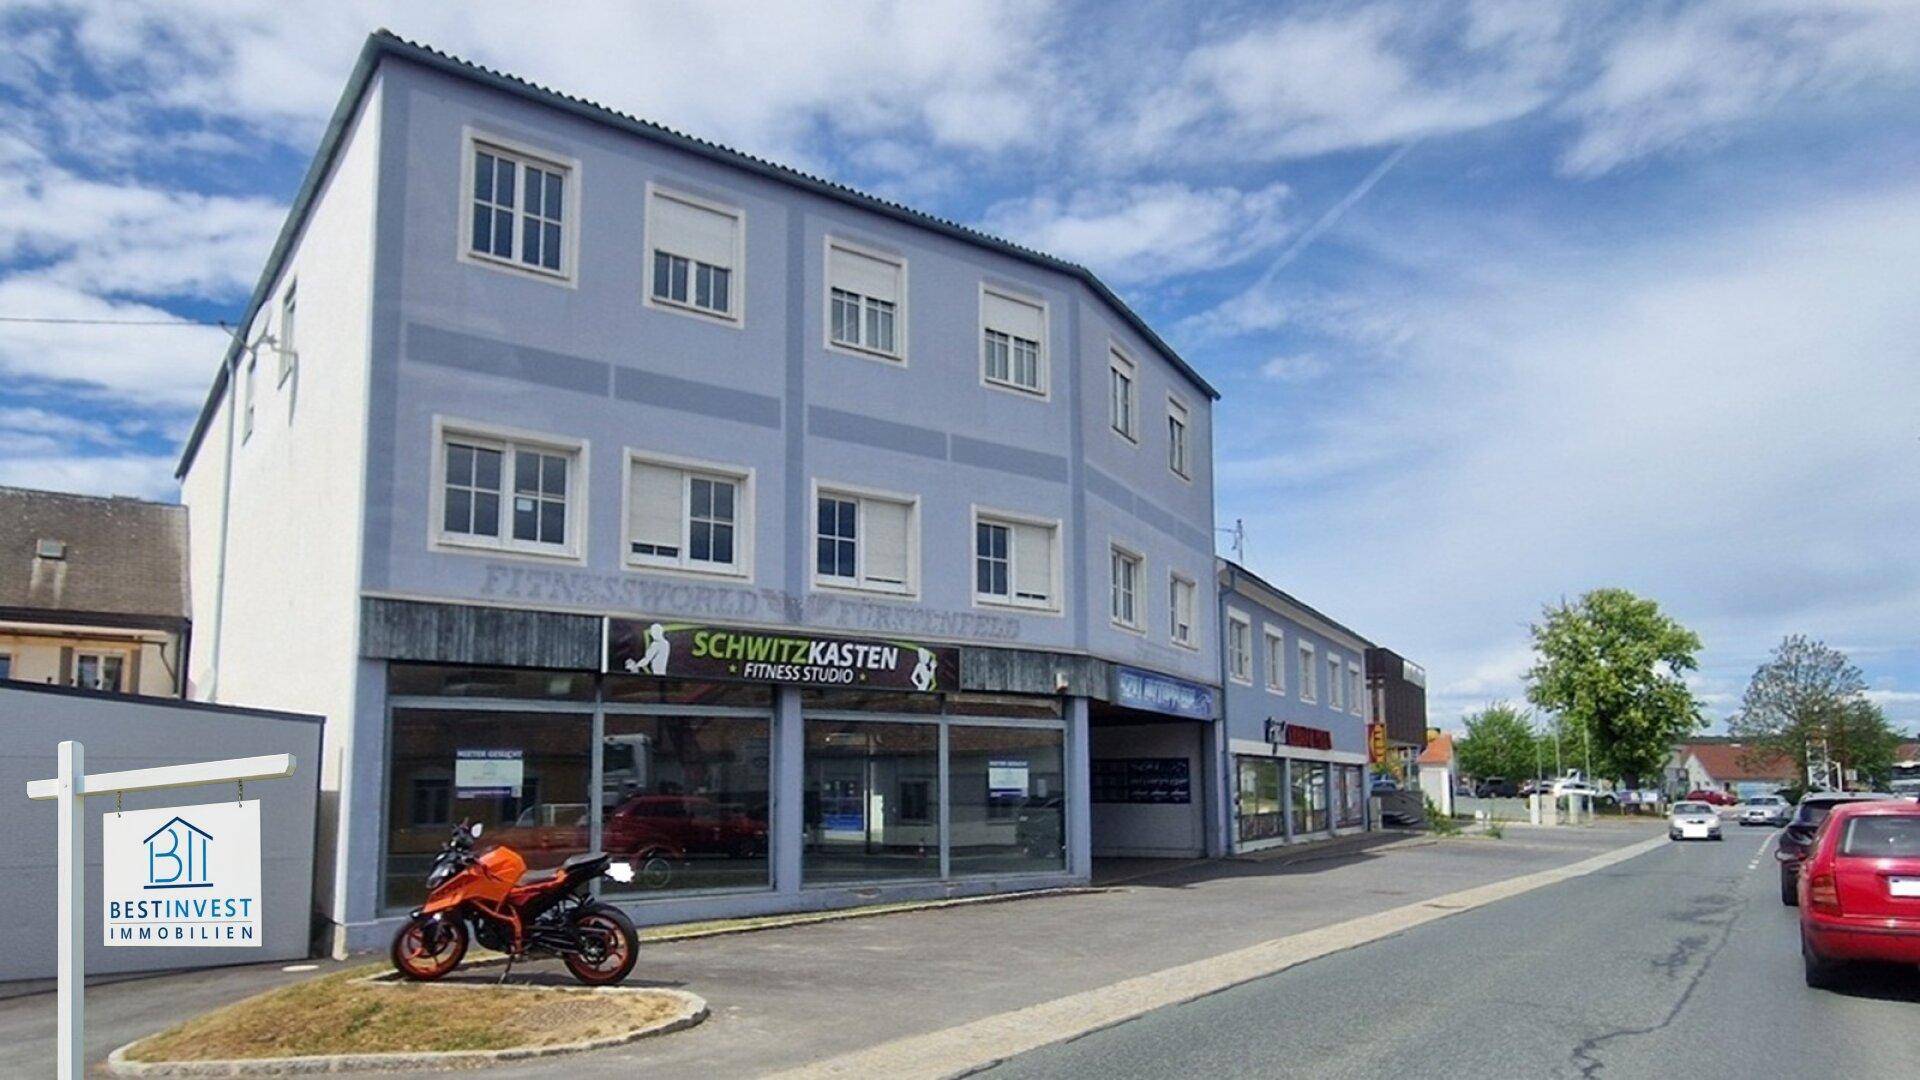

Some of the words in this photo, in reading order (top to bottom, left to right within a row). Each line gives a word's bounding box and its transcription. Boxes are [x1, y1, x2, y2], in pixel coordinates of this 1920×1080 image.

[692, 631, 898, 669] SCHWITZKASTEN
[744, 663, 800, 681] FITNESS
[802, 666, 853, 683] STUDIO
